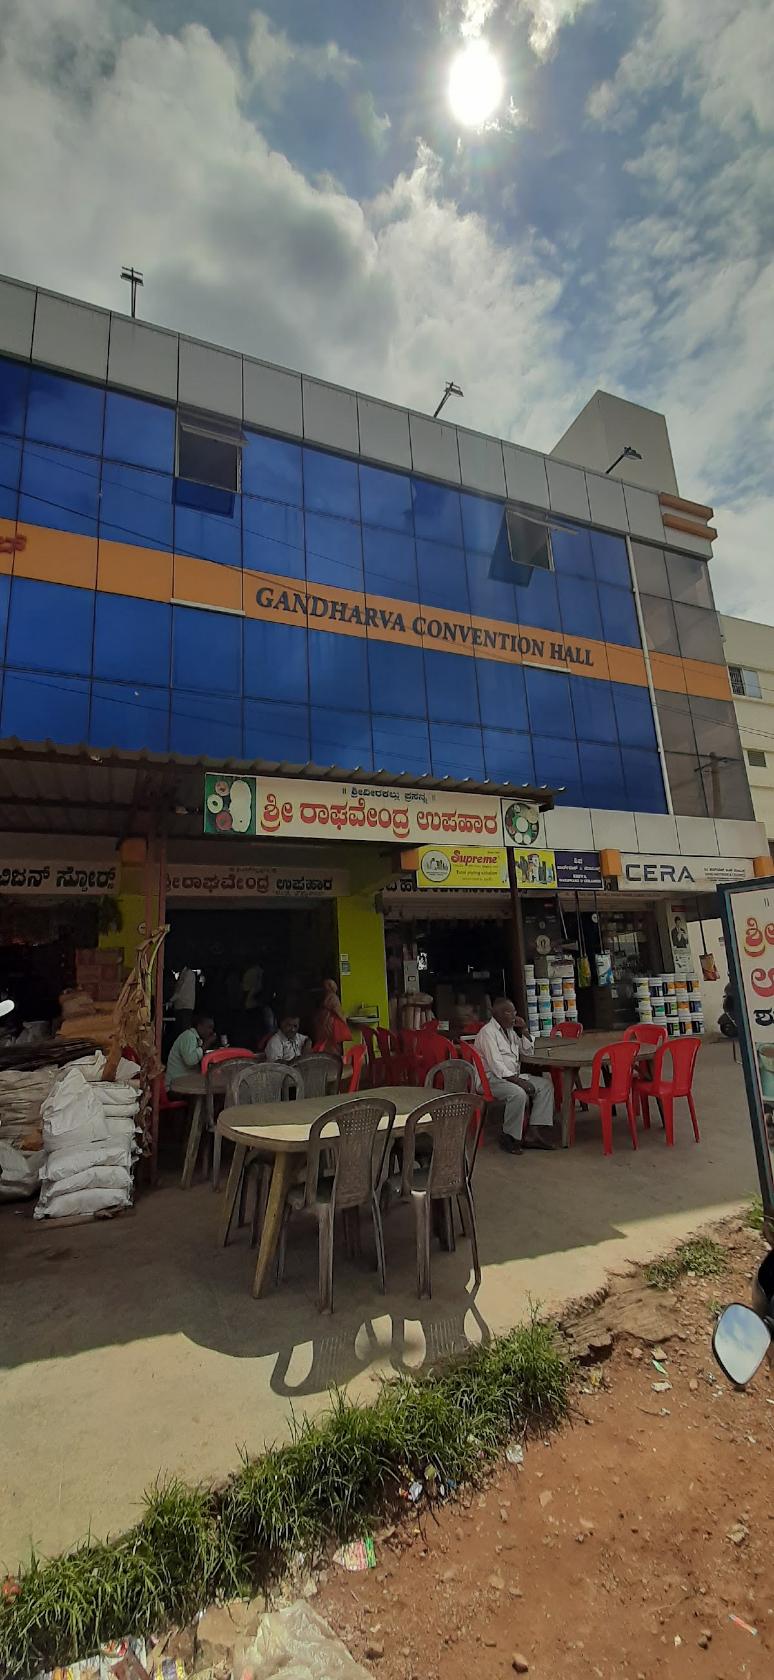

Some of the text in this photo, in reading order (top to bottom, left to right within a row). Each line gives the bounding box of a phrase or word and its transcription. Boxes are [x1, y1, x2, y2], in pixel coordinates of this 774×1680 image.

[255, 586, 595, 668] GANDHARVA CONVENTION HALL
[261, 793, 498, 839] ಶ್ರೀ ರಾಘವೇಂದ್ರ ಉಪಹಾರ
[451, 849, 497, 866] Supreme
[625, 864, 695, 883] CERA
[276, 876, 333, 891] ಉಪಹಾರ
